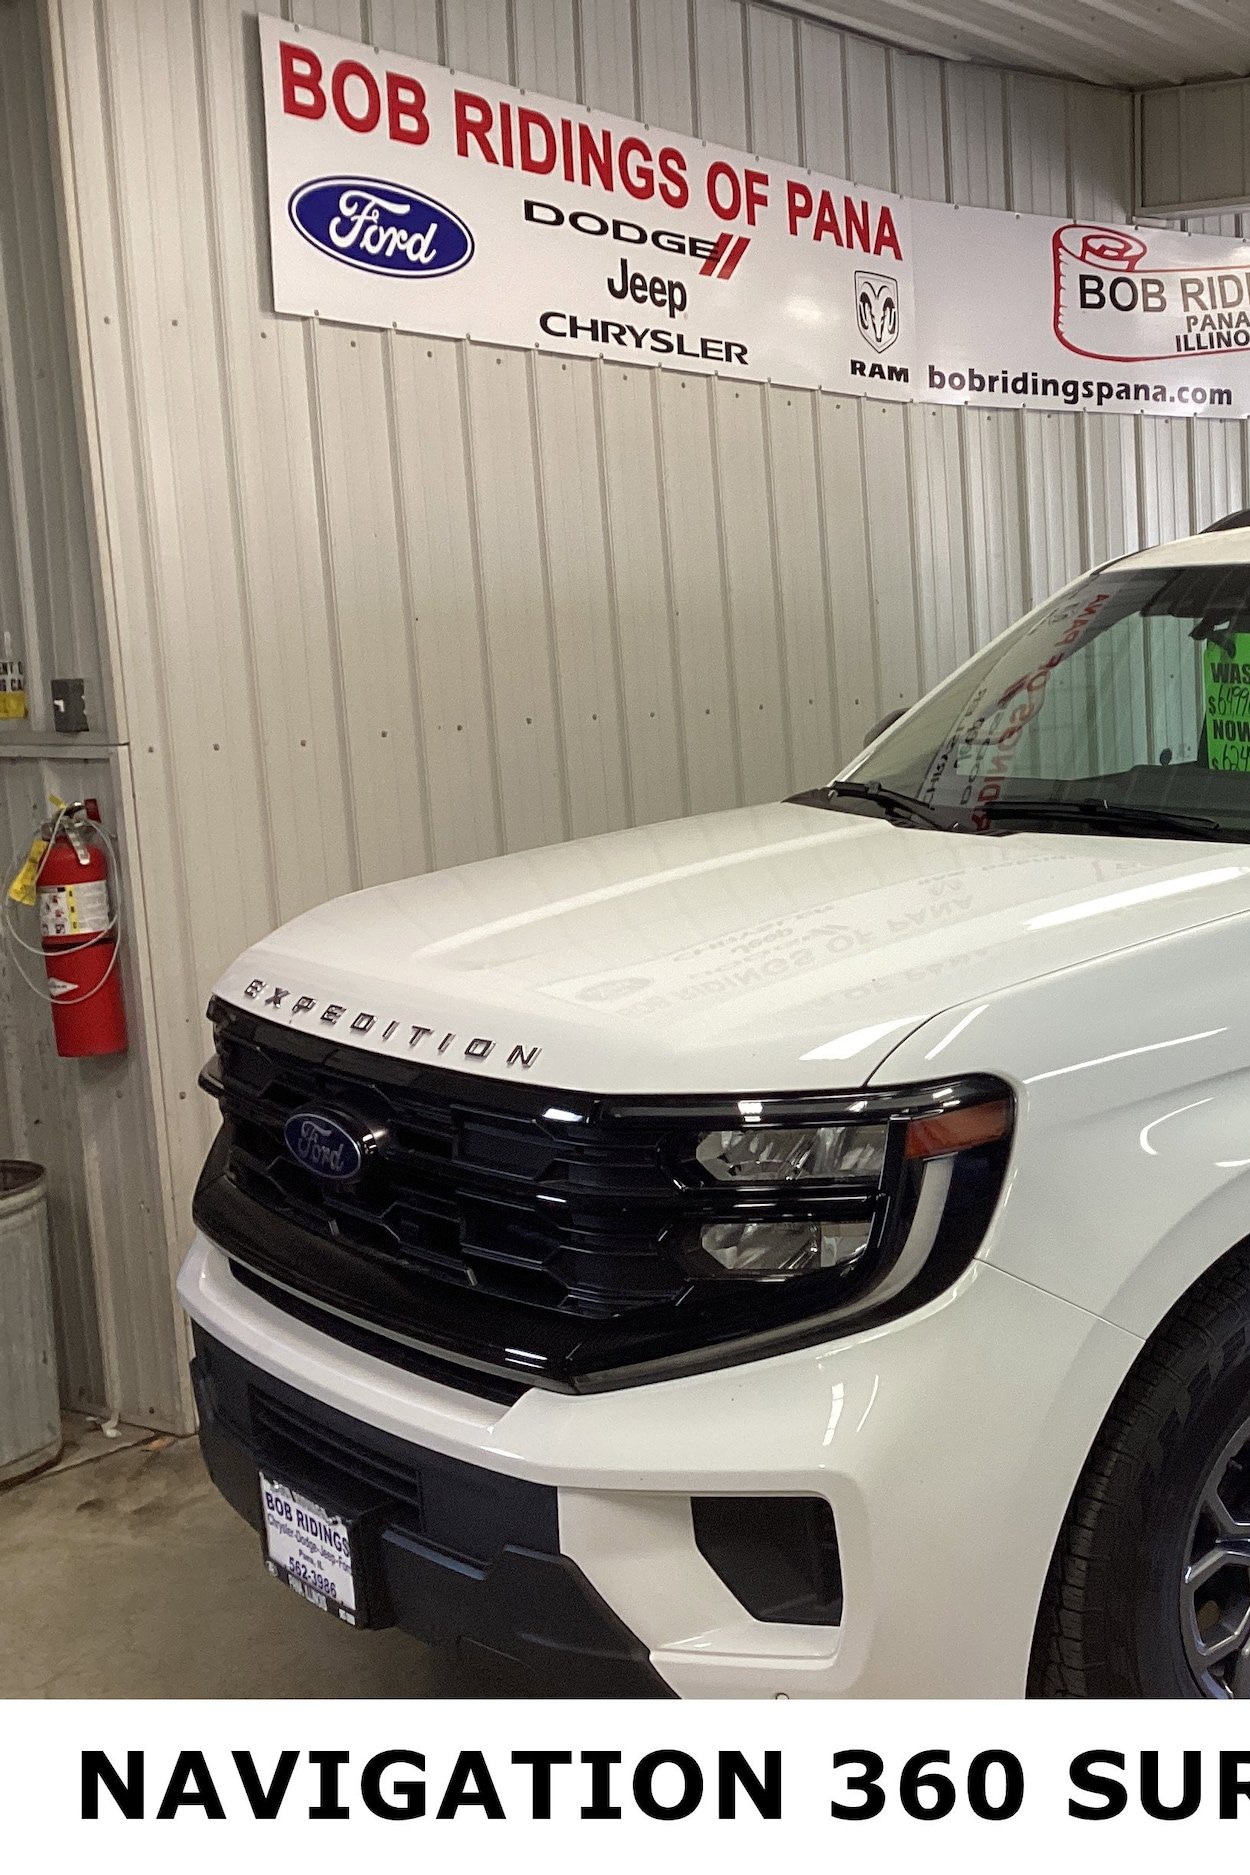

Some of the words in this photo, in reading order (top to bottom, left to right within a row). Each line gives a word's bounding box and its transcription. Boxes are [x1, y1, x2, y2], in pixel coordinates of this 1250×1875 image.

[278, 41, 430, 147] BOB
[453, 89, 690, 210] RIDINGS
[706, 160, 769, 227] OF
[786, 179, 903, 261] PANA
[327, 187, 439, 265] Ford
[523, 199, 718, 260] DODGE
[607, 257, 688, 319] Jeep
[1079, 273, 1168, 313] BOB
[538, 311, 750, 366] CHRYSLER
[850, 359, 909, 383] RAM
[928, 364, 1233, 407] bobridingspana.com
[244, 978, 542, 1069] EXPEDITION
[299, 1120, 346, 1171] Ford
[264, 1491, 293, 1522] BOB
[296, 1509, 350, 1558] RIDINGS
[288, 1556, 338, 1599] 562-3986
